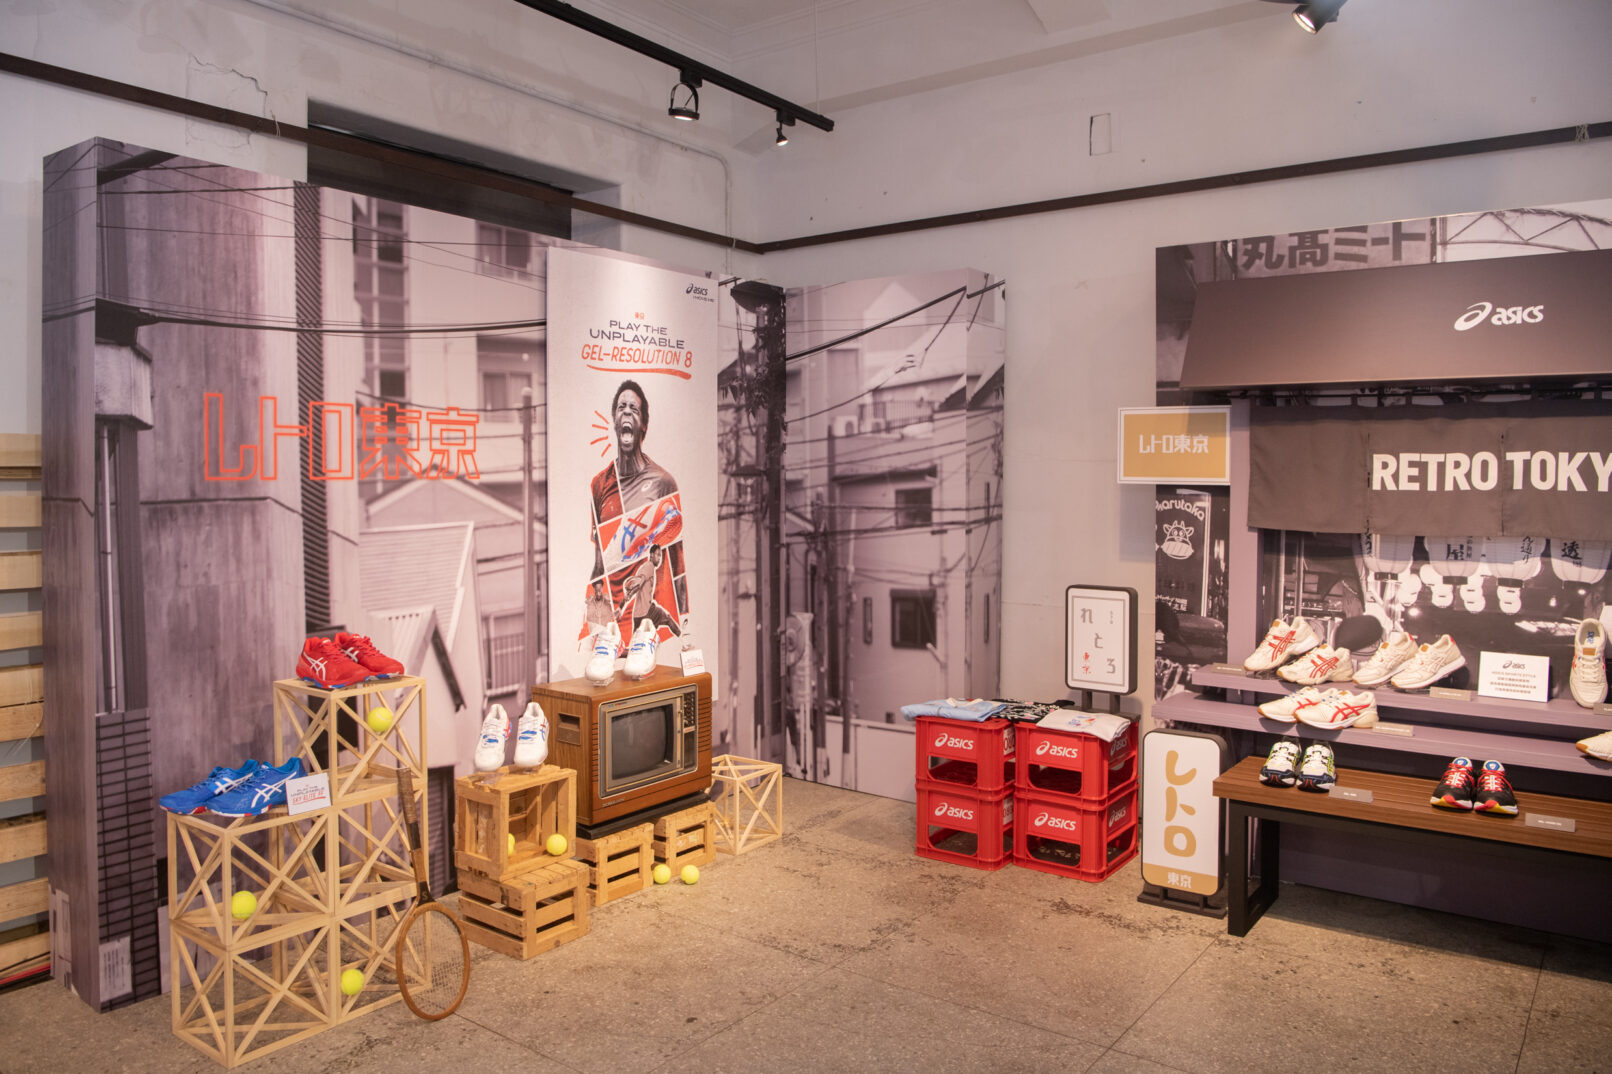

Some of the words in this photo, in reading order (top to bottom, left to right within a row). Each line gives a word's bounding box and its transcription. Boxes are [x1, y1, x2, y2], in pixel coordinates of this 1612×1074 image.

[693, 286, 708, 296] asics
[1491, 304, 1544, 325] asics
[609, 320, 640, 332] PLAY
[645, 324, 668, 336] THE
[589, 328, 685, 350] UNPLAYABLE
[581, 343, 680, 365] GEL-RESOLUTION
[684, 351, 693, 368] 8
[1372, 451, 1499, 492] RETRO
[1505, 450, 1612, 492] TOKY
[947, 737, 974, 750] asics
[1049, 744, 1078, 759] asics
[947, 807, 974, 820] asics
[1047, 816, 1077, 831] asics
[1167, 871, 1193, 889] 東京
